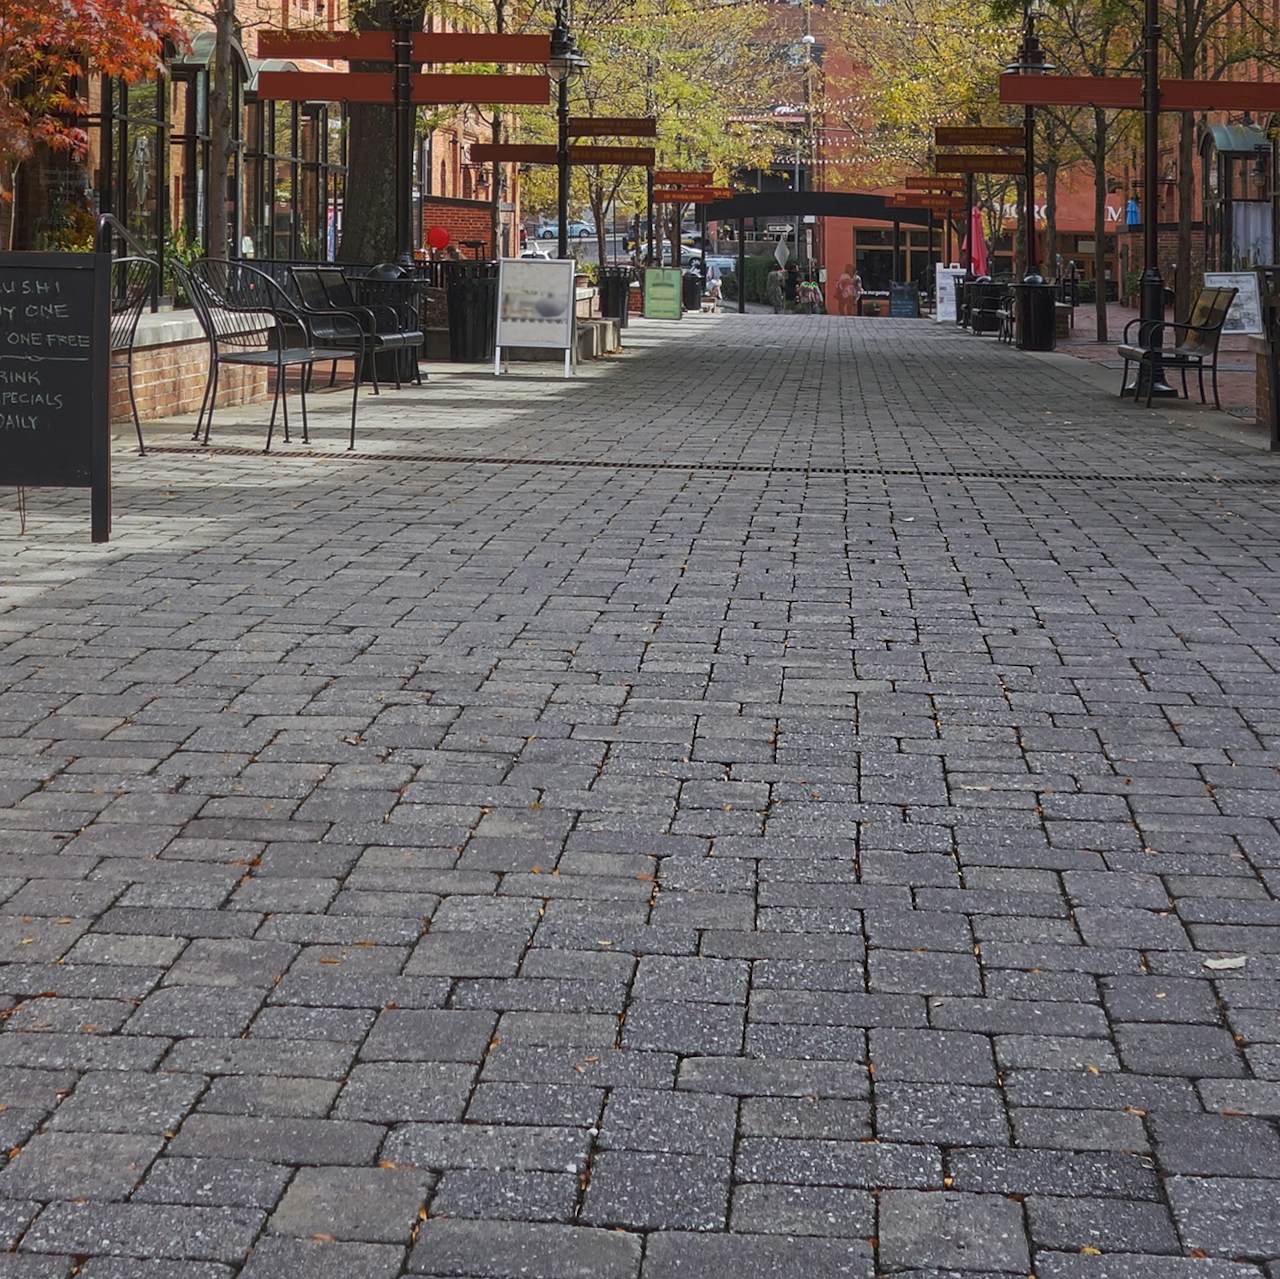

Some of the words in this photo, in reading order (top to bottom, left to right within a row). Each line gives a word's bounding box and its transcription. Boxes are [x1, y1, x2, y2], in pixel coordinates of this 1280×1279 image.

[25, 304, 69, 319] ONE
[7, 330, 42, 346] ONE
[46, 333, 90, 348] FREE
